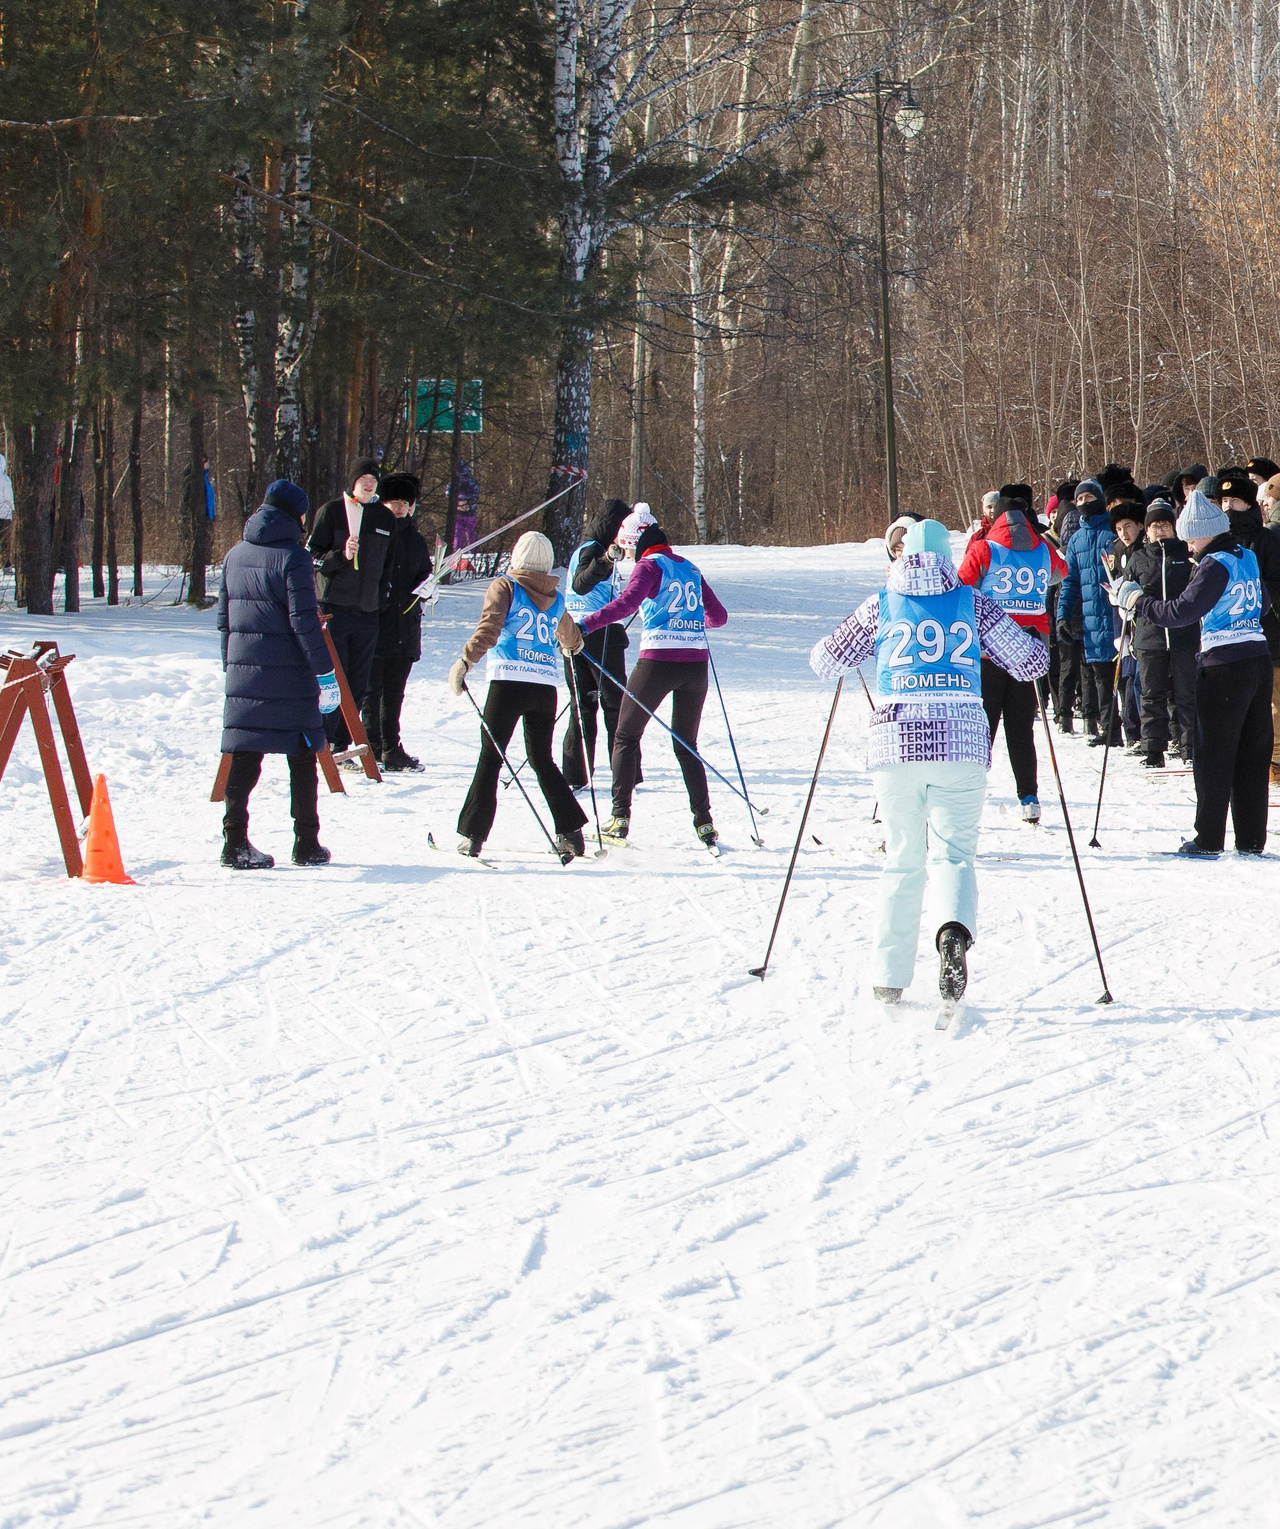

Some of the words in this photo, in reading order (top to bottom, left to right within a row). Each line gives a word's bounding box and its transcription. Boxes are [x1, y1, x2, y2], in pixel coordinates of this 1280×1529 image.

[992, 566, 1049, 595] 393
[886, 619, 975, 669] 292
[517, 648, 556, 665] ТЮМЕНЬ
[891, 673, 972, 691] ТЮМЕНЬ
[898, 721, 947, 732] TERMIT
[899, 731, 947, 743] TERMIT
[899, 742, 947, 754] TERMIT
